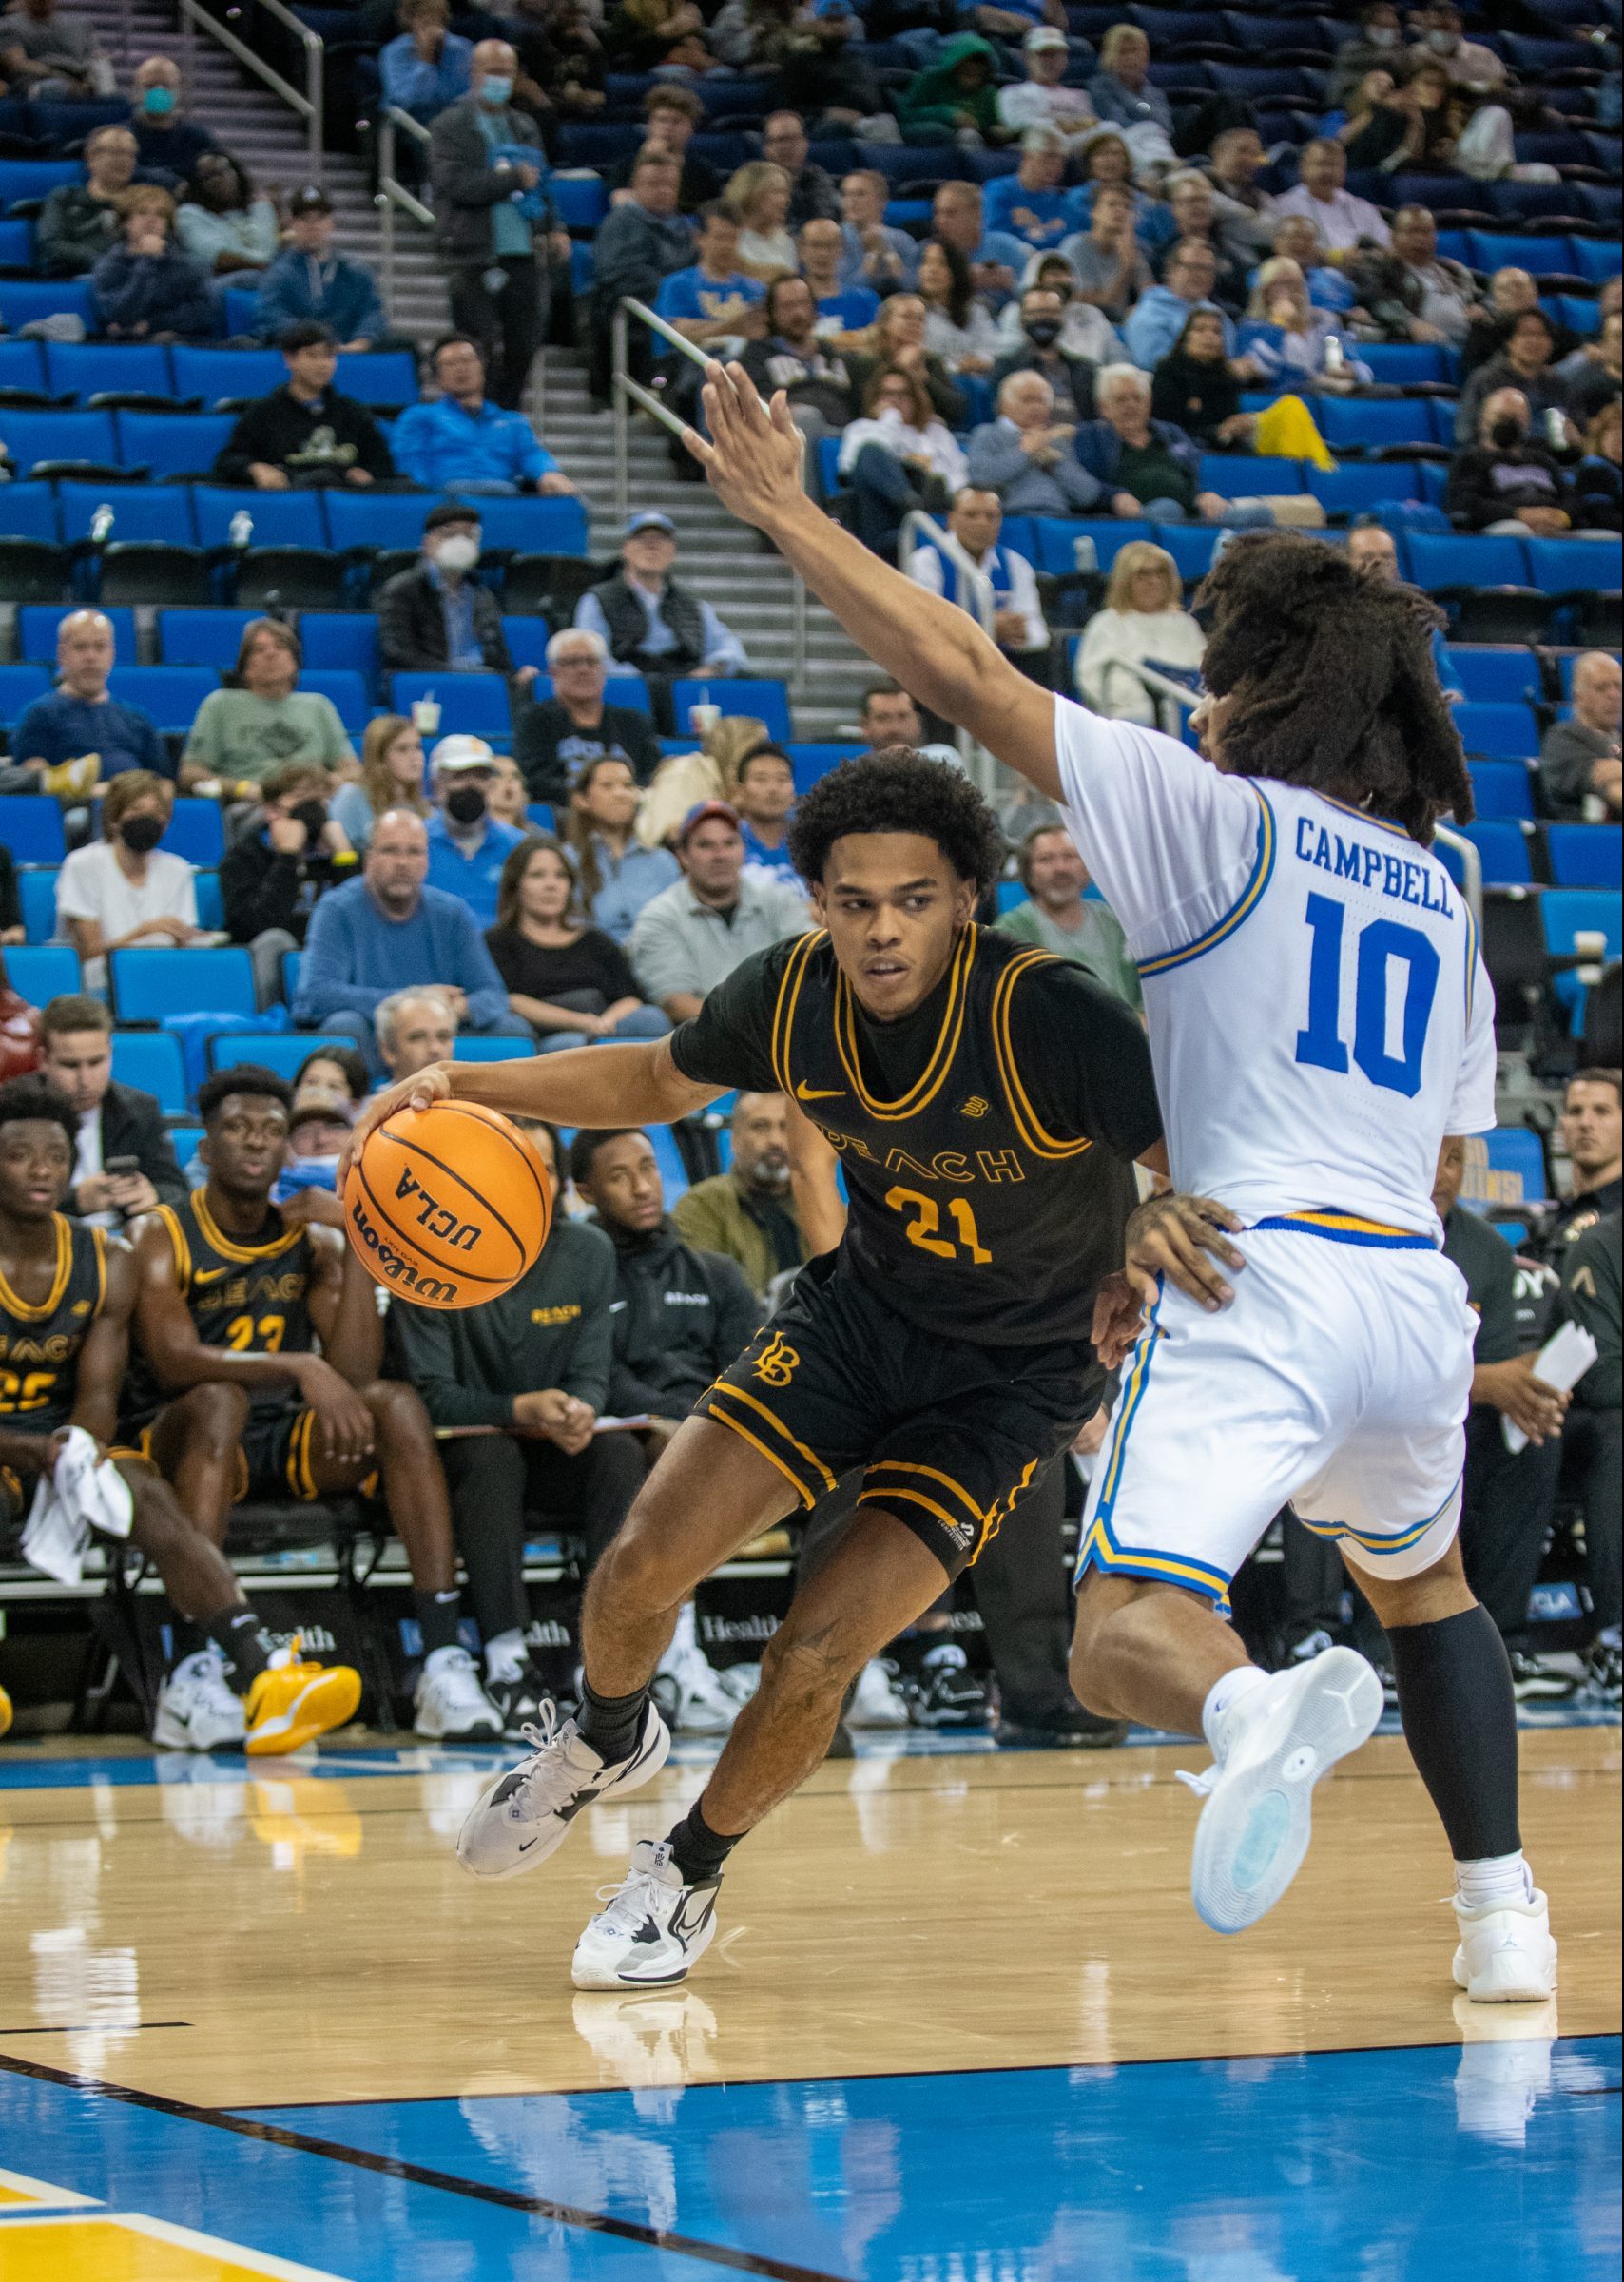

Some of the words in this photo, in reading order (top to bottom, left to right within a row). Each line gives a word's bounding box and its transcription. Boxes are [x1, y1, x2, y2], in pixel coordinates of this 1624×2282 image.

[1295, 816, 1453, 920] CAMPBELL
[1295, 890, 1440, 1099] 10
[352, 1198, 458, 1303] Wilson
[395, 1166, 482, 1251] UCLA
[885, 1186, 993, 1265] 21
